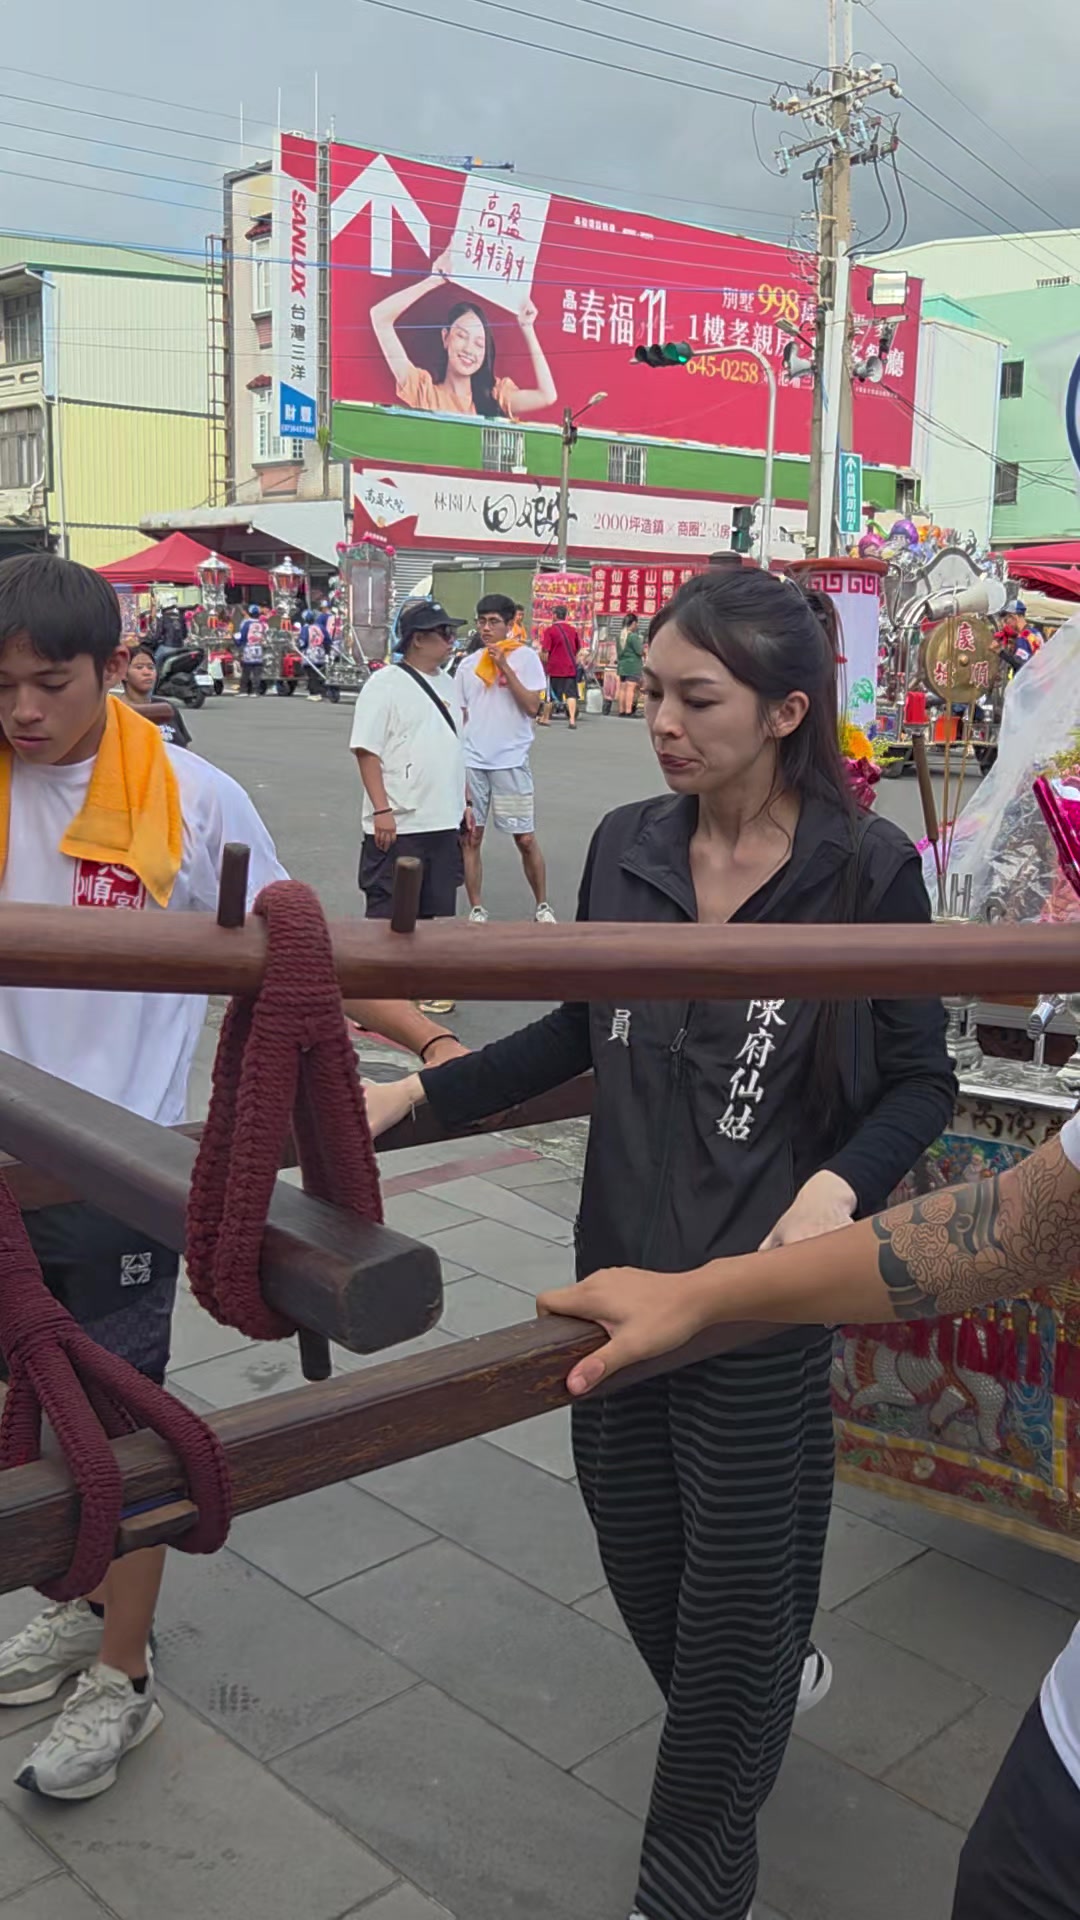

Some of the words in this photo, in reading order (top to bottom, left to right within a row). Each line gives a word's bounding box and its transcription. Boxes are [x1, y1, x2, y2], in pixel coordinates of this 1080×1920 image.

[480, 191, 526, 241] 高盈
[291, 189, 306, 298] SANLUX
[465, 226, 525, 284] 謝謝
[758, 283, 799, 321] 998
[291, 303, 306, 380] 台灣三洋
[434, 491, 477, 513] 林園人
[626, 569, 639, 613] 冬瓜茶
[608, 1008, 632, 1047] 員
[716, 998, 787, 1141] 陳府仙姑
